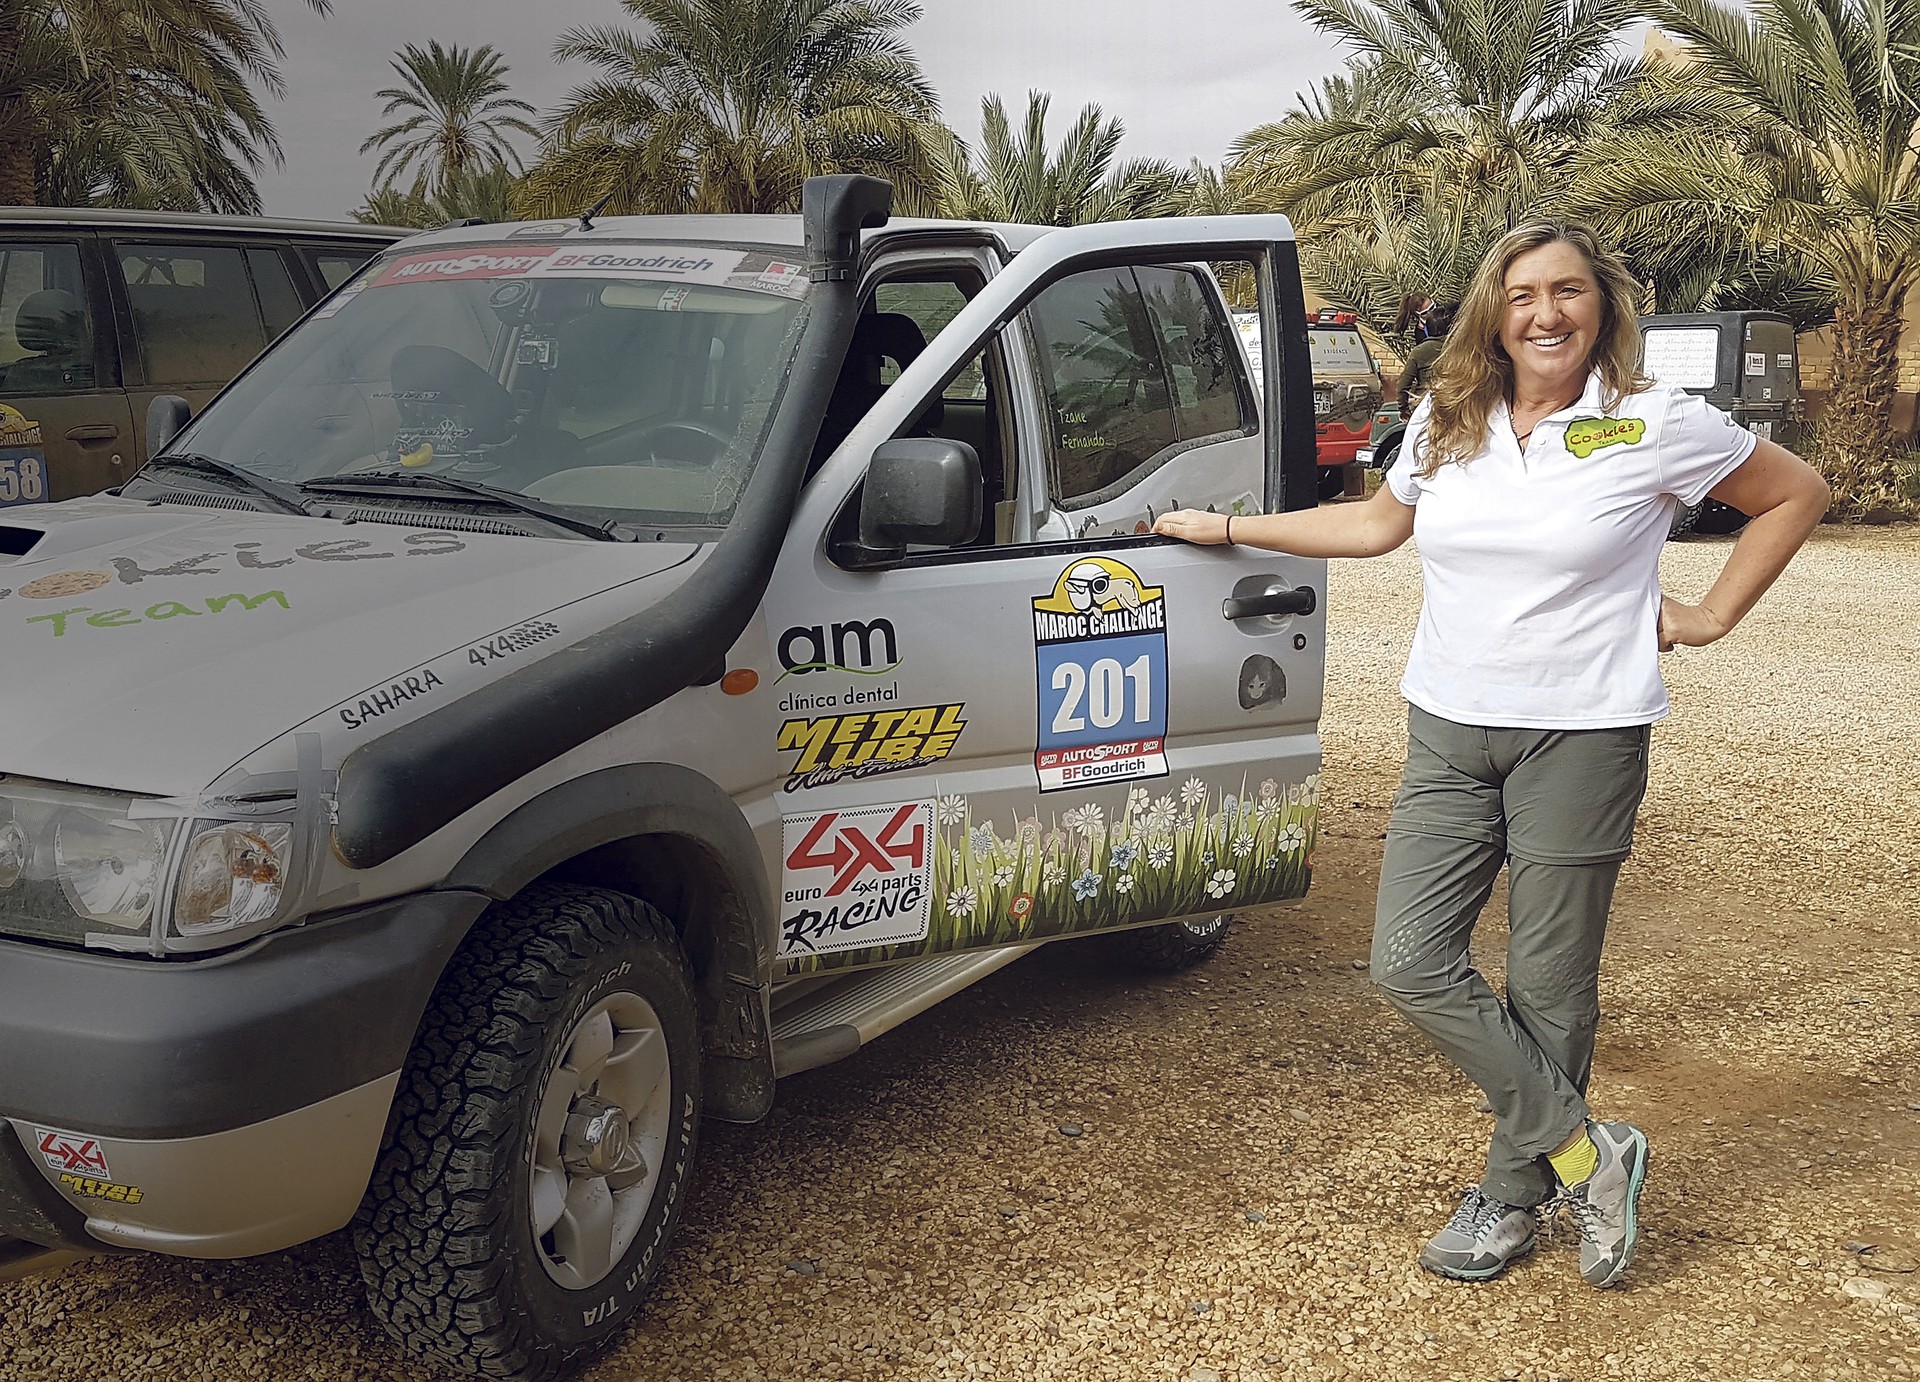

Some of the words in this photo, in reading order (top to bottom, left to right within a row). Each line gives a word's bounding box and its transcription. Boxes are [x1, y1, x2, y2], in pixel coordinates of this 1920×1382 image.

[552, 254, 714, 272] BFGoodrich
[750, 280, 790, 294] MAROC
[1061, 430, 1105, 449] Fernando
[26, 590, 292, 637] Team
[1035, 611, 1088, 641] MAROC
[1089, 599, 1164, 636] CHALLENGE
[777, 617, 898, 675] am
[339, 669, 444, 730] SAHARA
[778, 692, 837, 712] clínica
[843, 681, 899, 705] dental
[1051, 654, 1150, 734] 201
[777, 704, 965, 751] METAL
[1062, 758, 1146, 780] BFGoodrich
[784, 887, 822, 903] euro
[881, 873, 922, 895] parts
[60, 1173, 142, 1196] METAL
[582, 1295, 619, 1327] T/A
